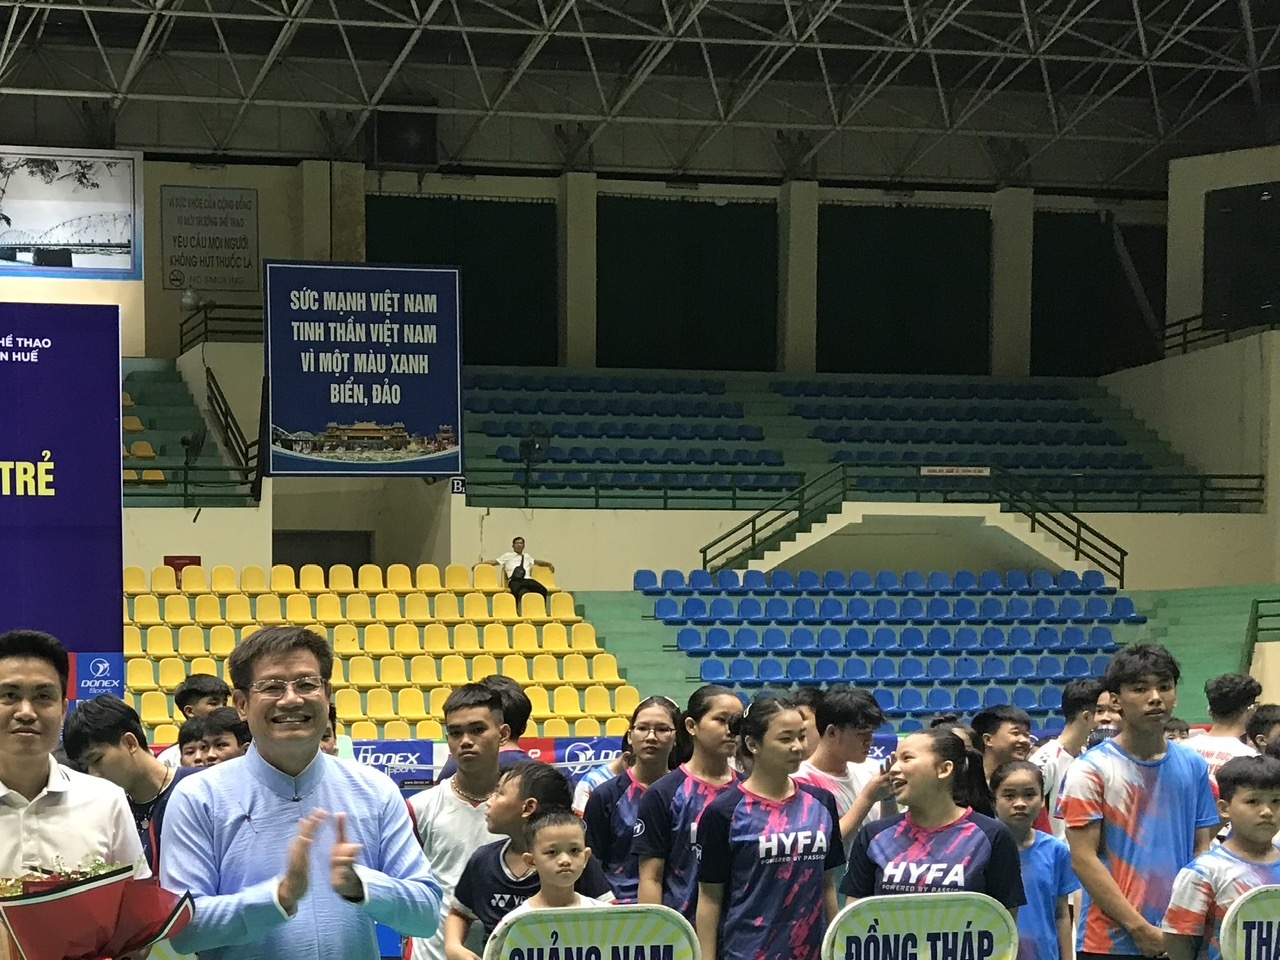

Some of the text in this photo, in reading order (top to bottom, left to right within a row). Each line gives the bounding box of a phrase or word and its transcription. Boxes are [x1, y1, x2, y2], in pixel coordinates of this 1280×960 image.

[290, 287, 437, 316] SỨC MẠNH VIỆT NAM
[16, 337, 52, 349] THAO
[291, 316, 437, 347] TINH THẦN VIỆT NAM
[16, 349, 39, 362] HUẾ
[301, 349, 429, 376] VÌ MỘT MÀU XANH
[330, 376, 401, 406] BIỂN, ĐẢO
[81, 679, 120, 688] DONEX
[759, 830, 827, 859] HYFA
[882, 861, 965, 886] HYFA
[882, 884, 915, 892] POWERED
